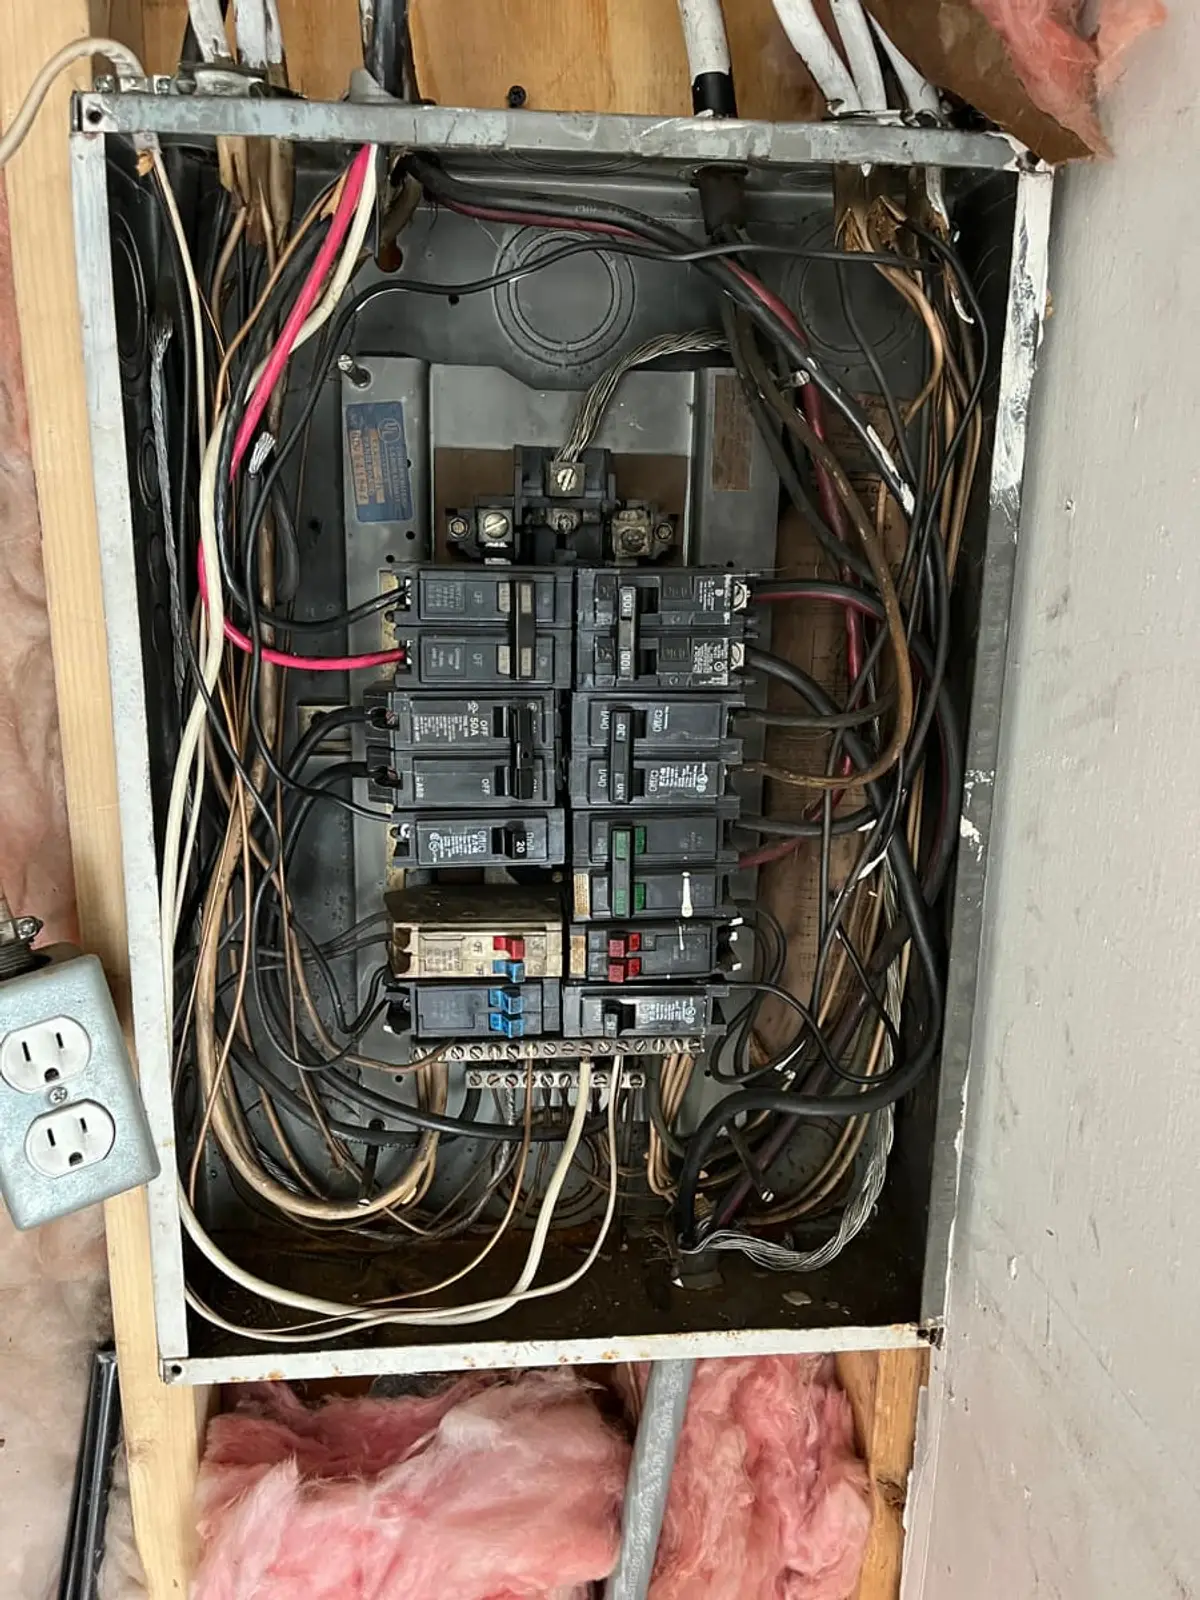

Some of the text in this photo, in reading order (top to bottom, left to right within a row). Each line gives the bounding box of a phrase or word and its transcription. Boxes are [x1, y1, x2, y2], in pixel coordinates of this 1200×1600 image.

[622, 594, 632, 612] 100
[620, 653, 631, 671] 100
[470, 717, 479, 736] 50A
[480, 720, 488, 736] OFF
[481, 778, 490, 795] OFF
[516, 840, 525, 853] 20
[606, 1021, 615, 1030] 15
